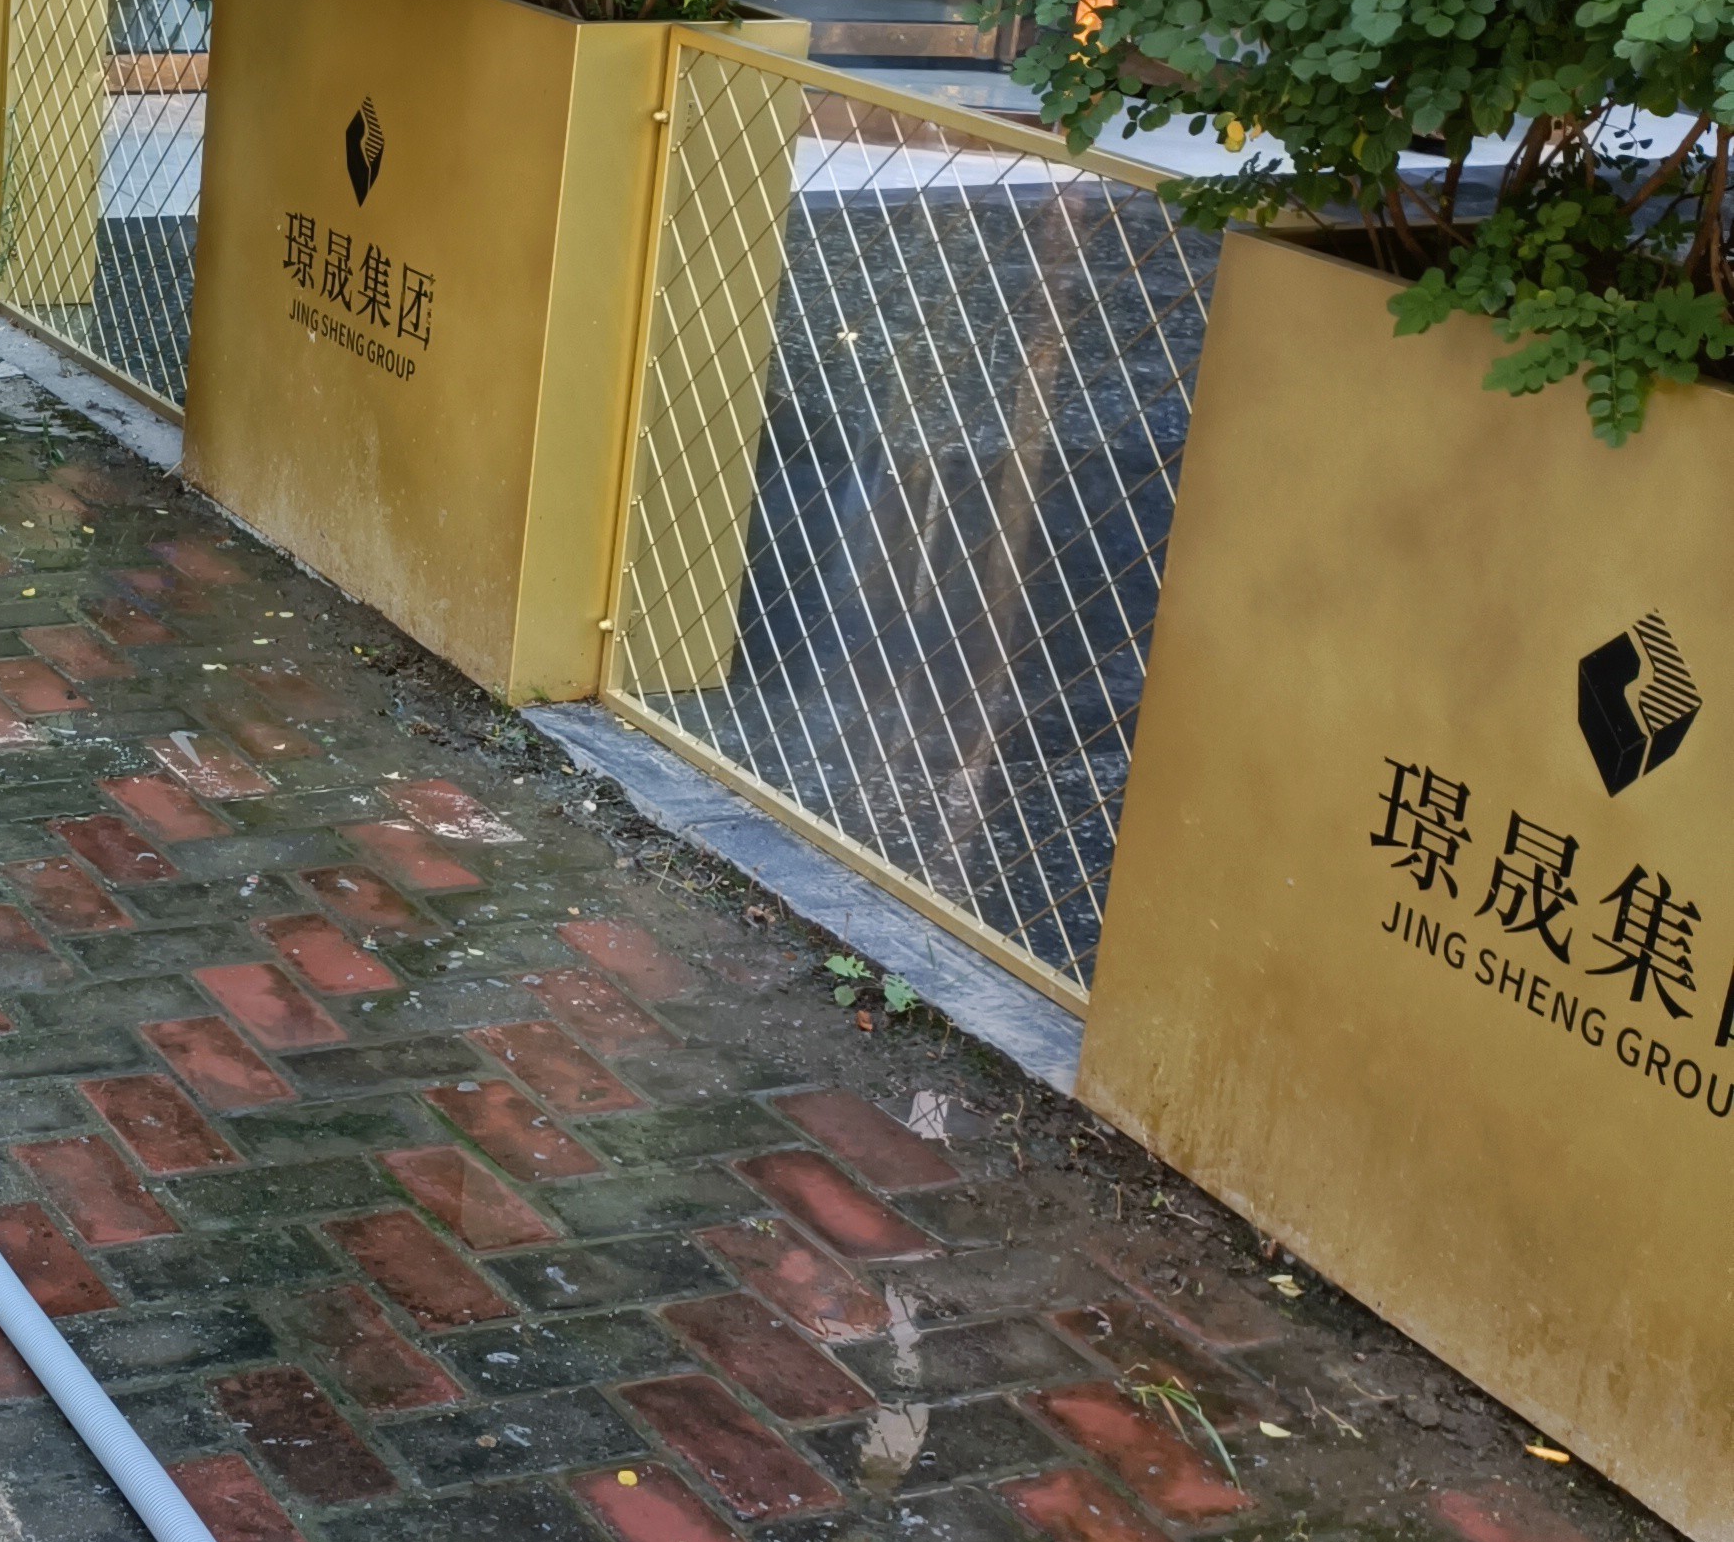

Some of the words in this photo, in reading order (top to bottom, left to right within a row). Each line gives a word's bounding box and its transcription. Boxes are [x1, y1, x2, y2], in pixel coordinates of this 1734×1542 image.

[283, 211, 436, 352] 璟晟集团
[289, 297, 320, 333] JING
[322, 317, 365, 358] SHENG
[367, 340, 416, 382] GROUP
[1369, 756, 1734, 1049] 璟晟集
[1381, 900, 1468, 971] JING
[1474, 948, 1606, 1048] SHENG
